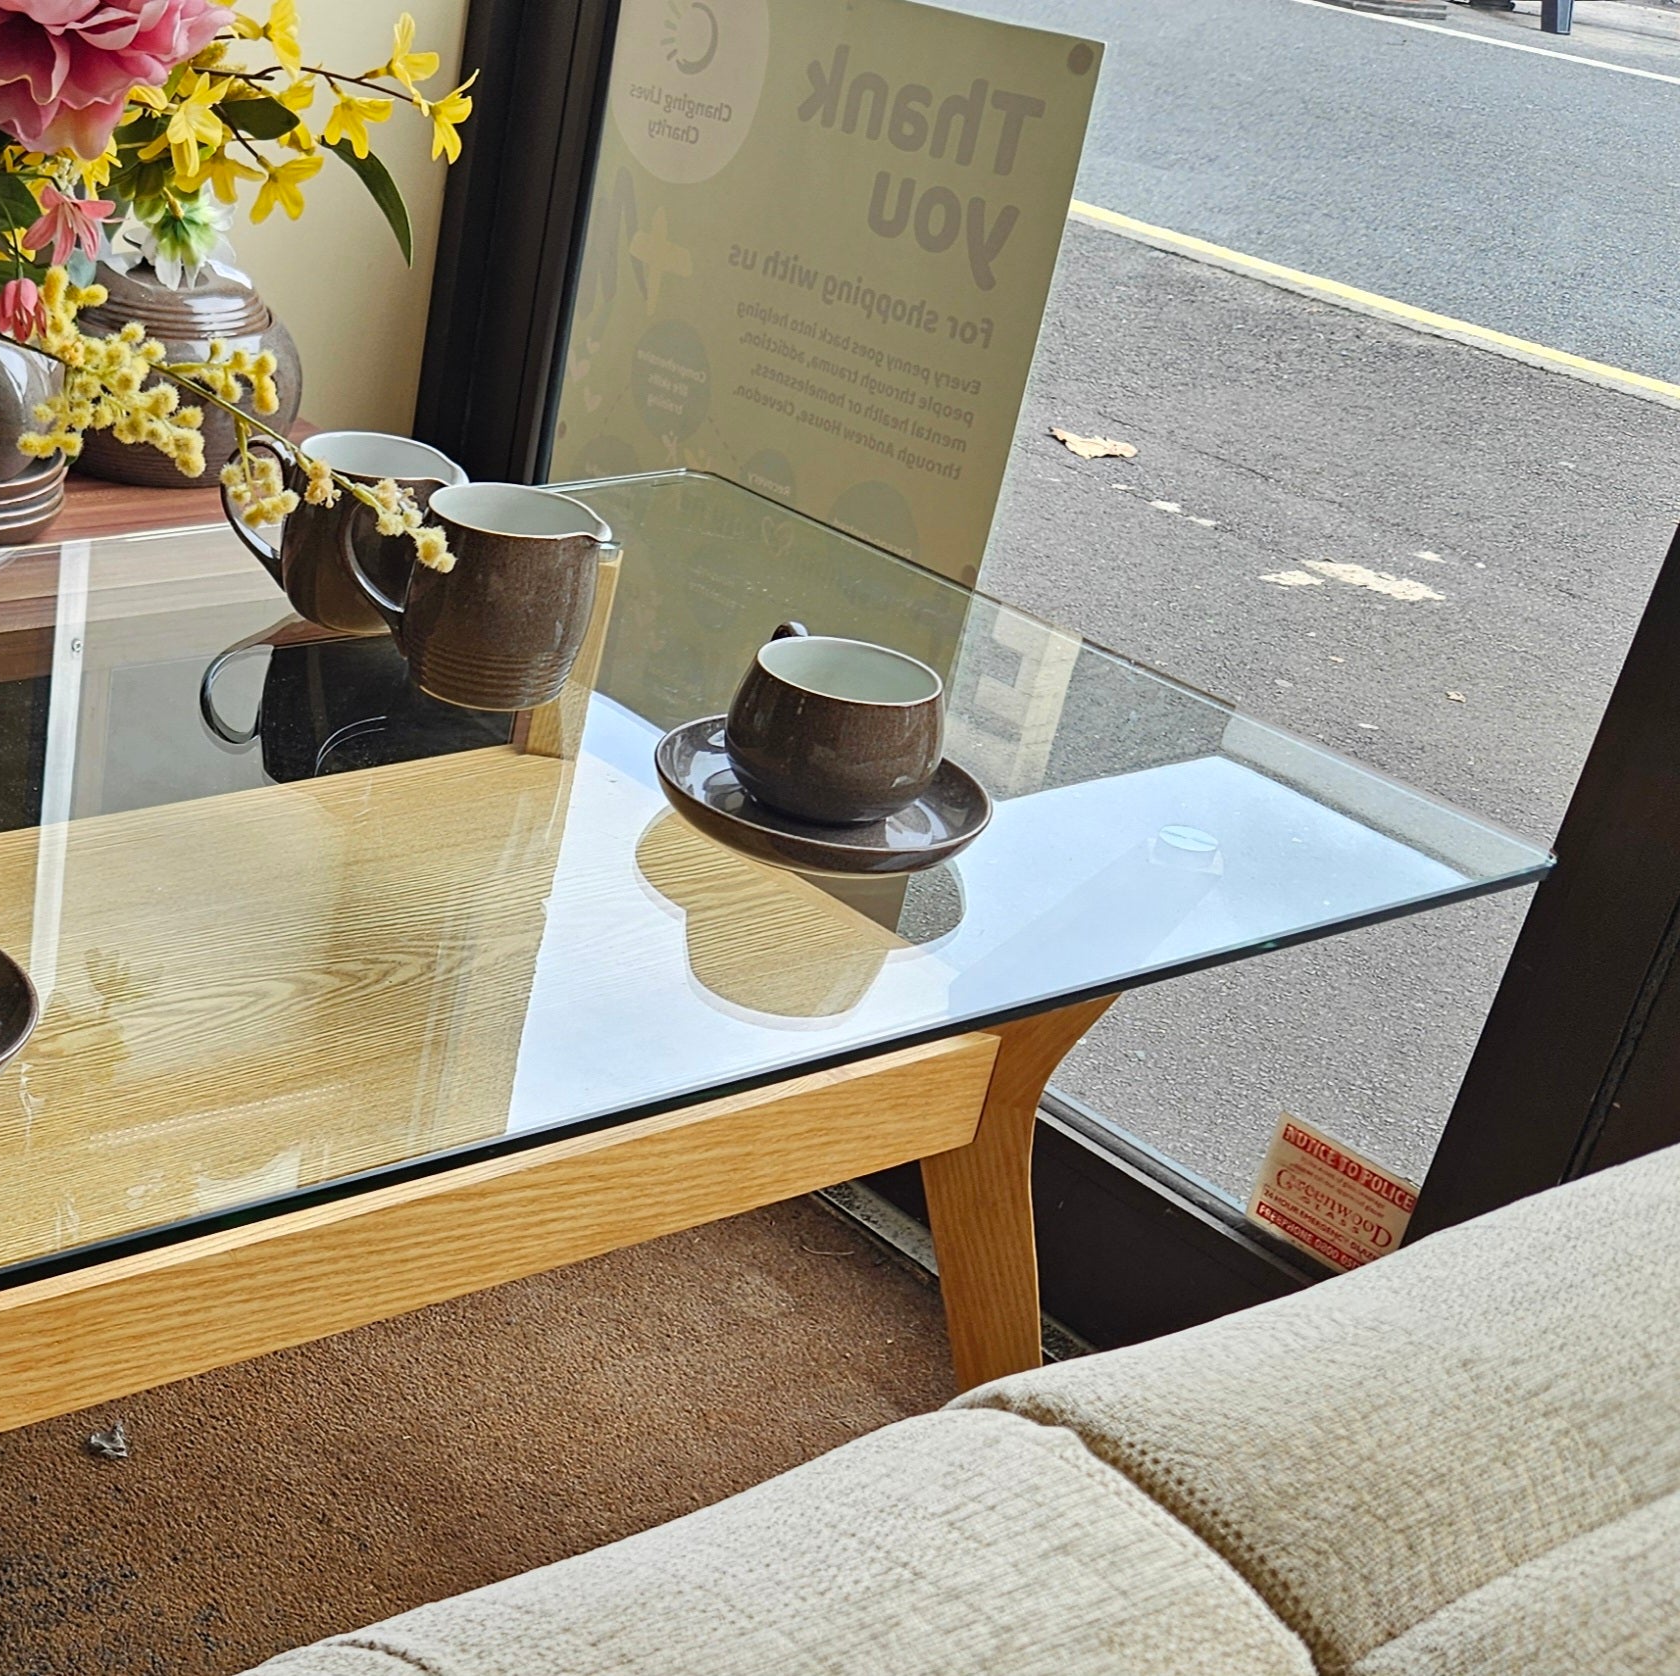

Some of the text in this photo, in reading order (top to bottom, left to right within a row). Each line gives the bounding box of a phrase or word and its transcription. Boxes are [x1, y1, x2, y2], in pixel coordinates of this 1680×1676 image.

[1284, 1126, 1339, 1166] NOTICE
[1336, 1155, 1360, 1180] TO
[1359, 1168, 1415, 1212] POLICE
